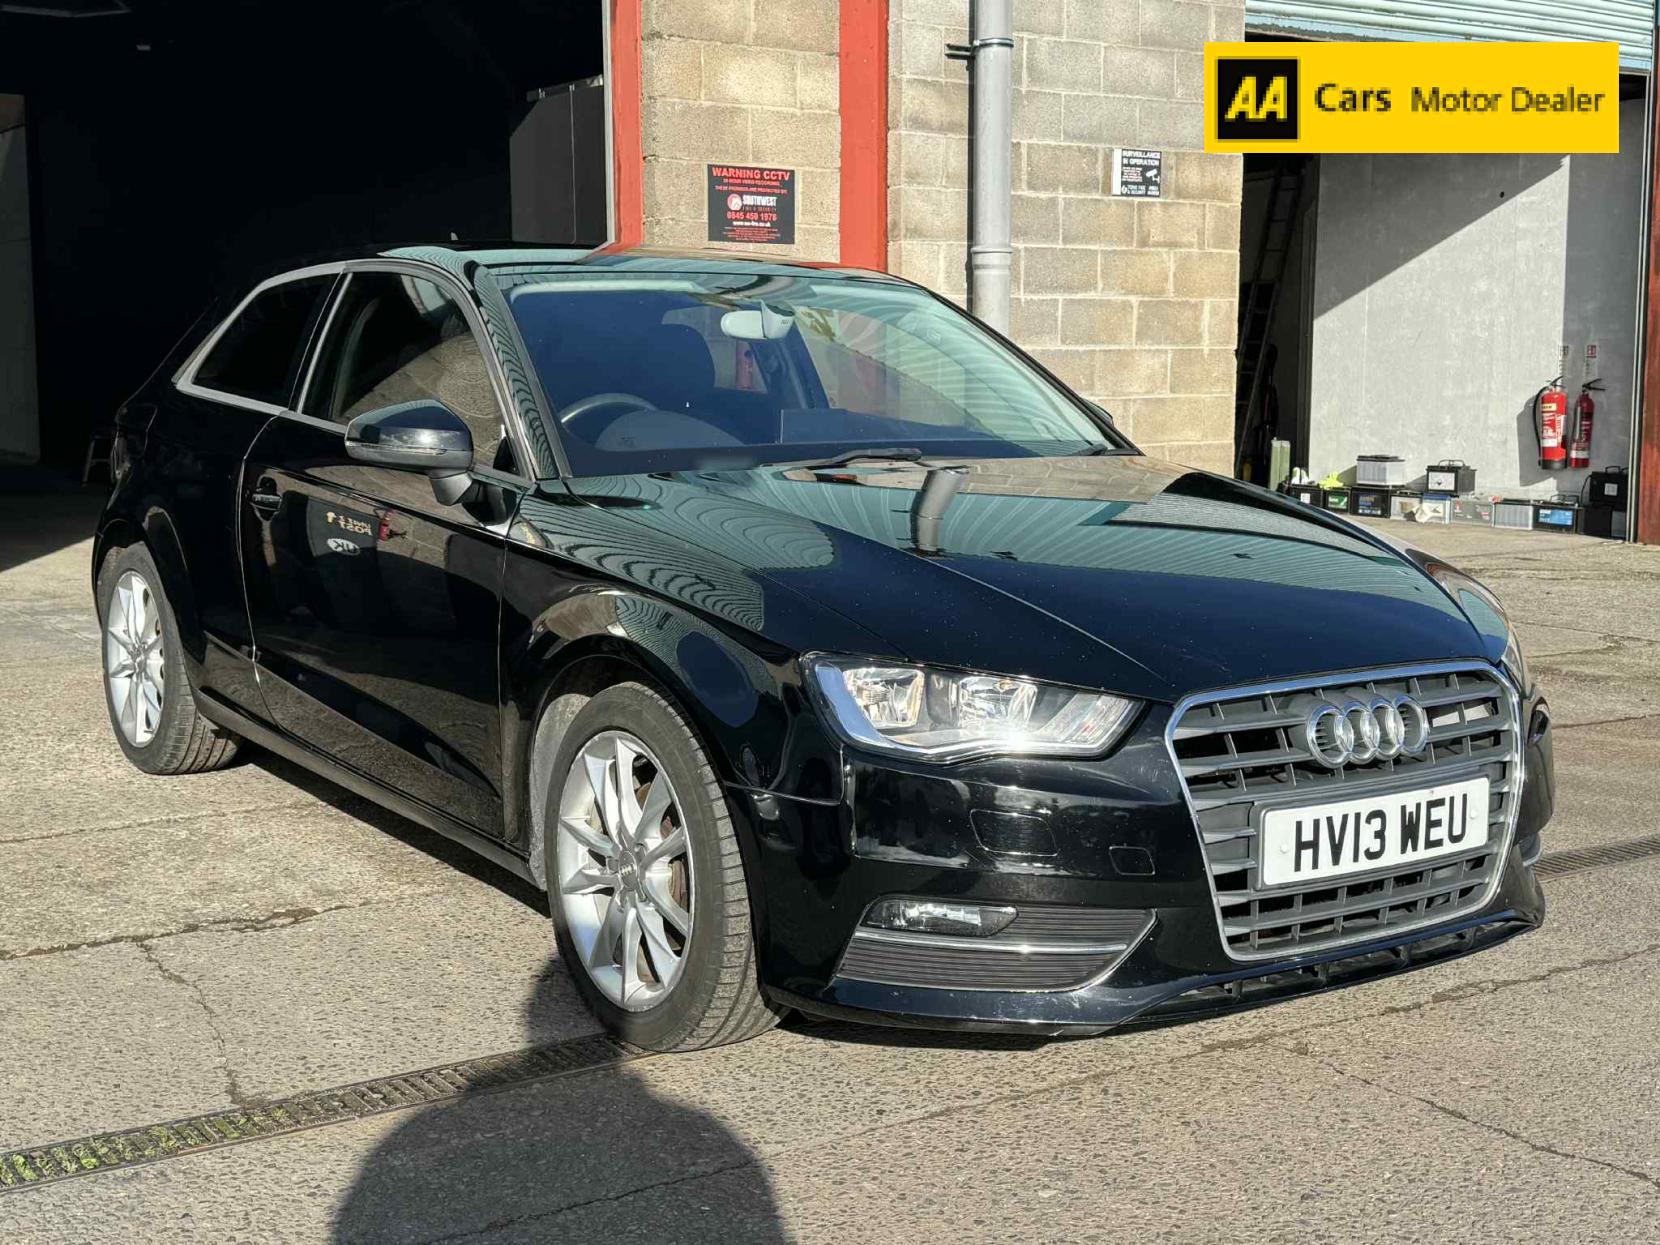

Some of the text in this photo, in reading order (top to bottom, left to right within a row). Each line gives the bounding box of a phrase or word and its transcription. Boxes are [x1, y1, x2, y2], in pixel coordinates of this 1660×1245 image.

[712, 167, 790, 181] WARNING CCTV
[742, 195, 777, 206] SOUTHWEST
[1294, 793, 1468, 872] HV13 WEU
